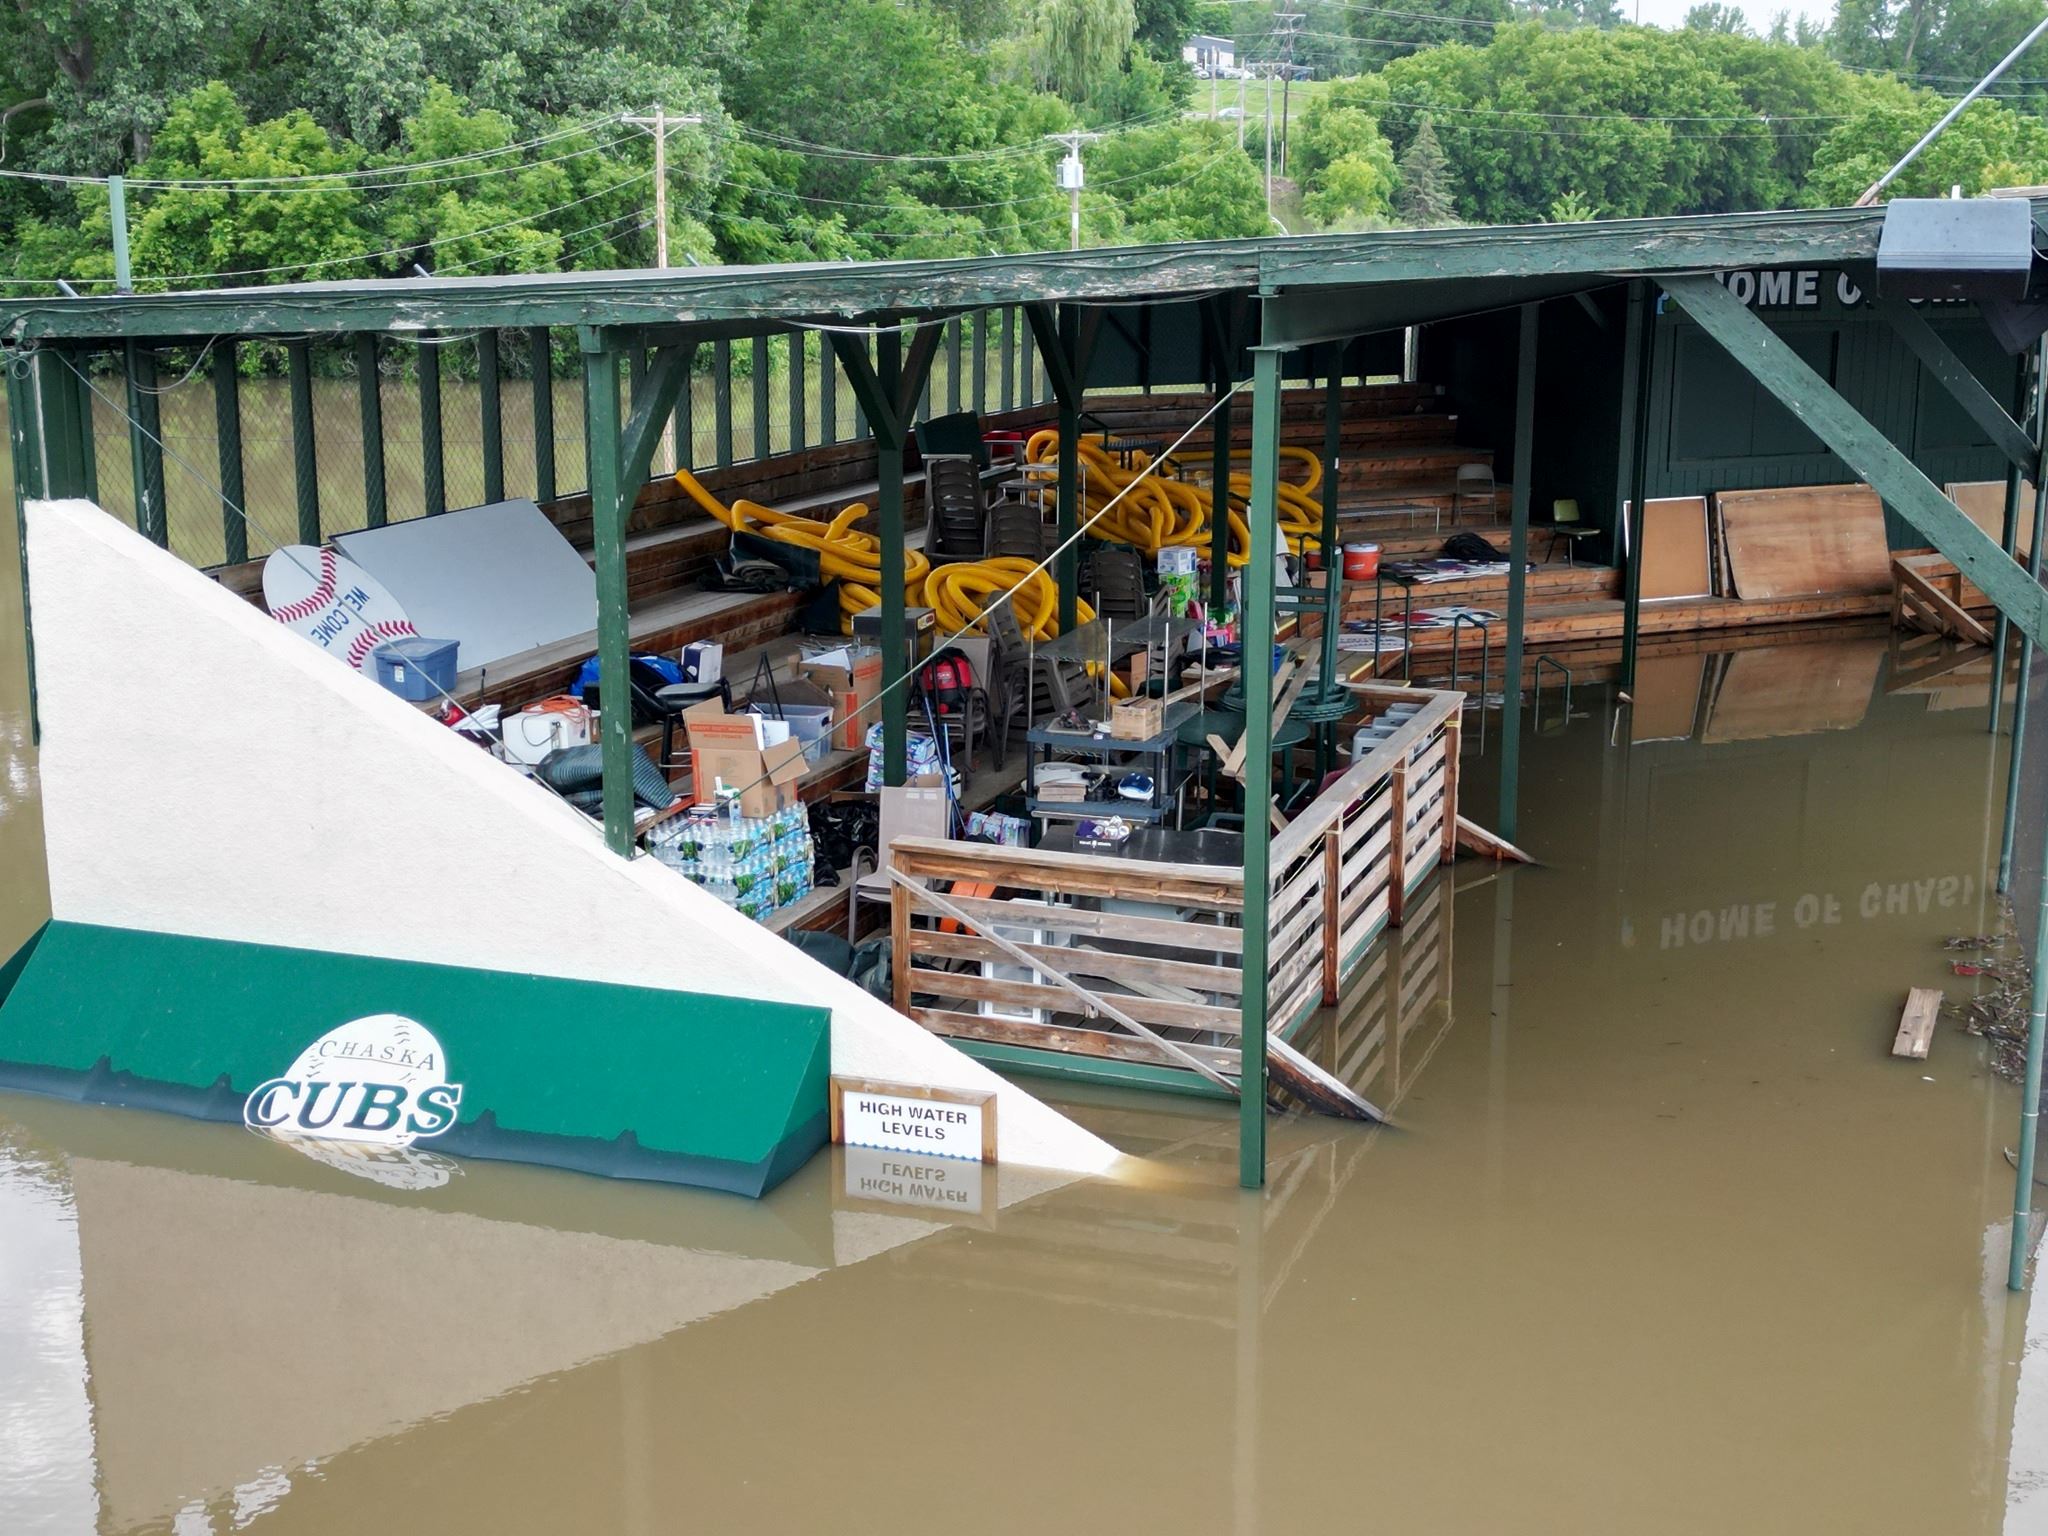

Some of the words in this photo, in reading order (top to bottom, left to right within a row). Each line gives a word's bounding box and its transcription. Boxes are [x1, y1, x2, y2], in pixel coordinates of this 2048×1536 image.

[1715, 271, 1819, 305] OME
[1837, 271, 1871, 305] O
[319, 1039, 435, 1071] CHASKA
[246, 1079, 462, 1135] CUBS
[859, 1100, 902, 1117] HIGH
[908, 1106, 968, 1125] WATER
[881, 1121, 946, 1140] LEVELS
